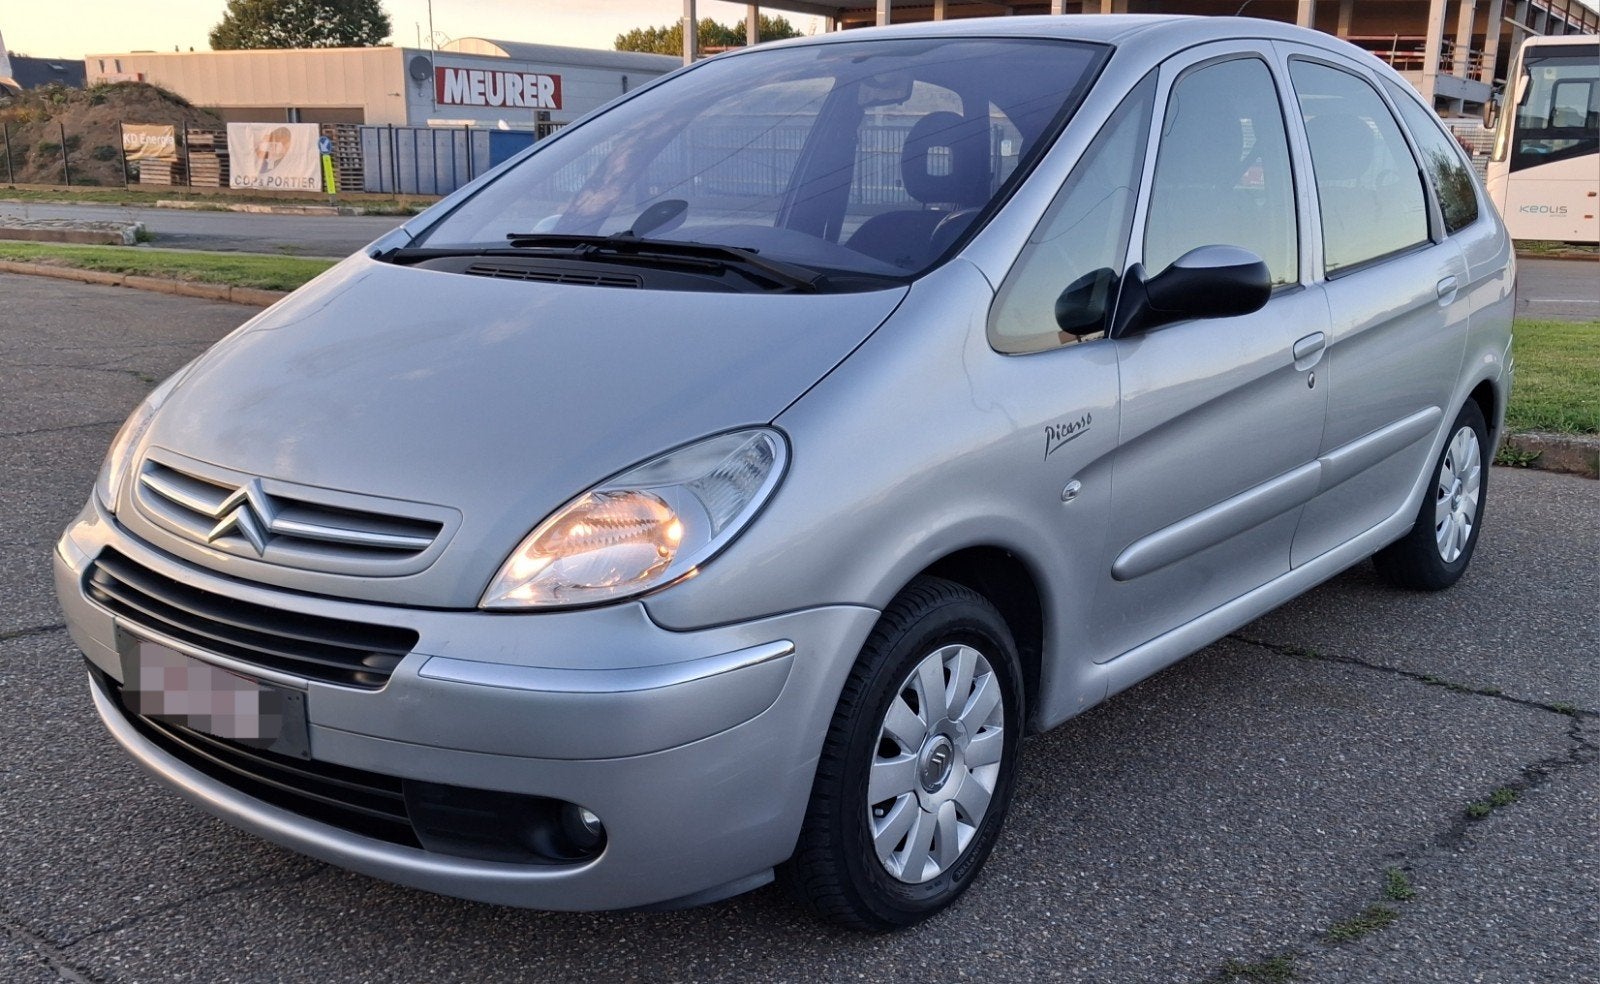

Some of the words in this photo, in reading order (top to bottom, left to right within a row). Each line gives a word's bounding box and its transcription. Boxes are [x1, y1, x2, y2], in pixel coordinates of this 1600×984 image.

[443, 68, 556, 108] MEURER
[122, 133, 138, 145] KD
[266, 176, 315, 189] PORTIER
[1044, 412, 1092, 461] Picasso
